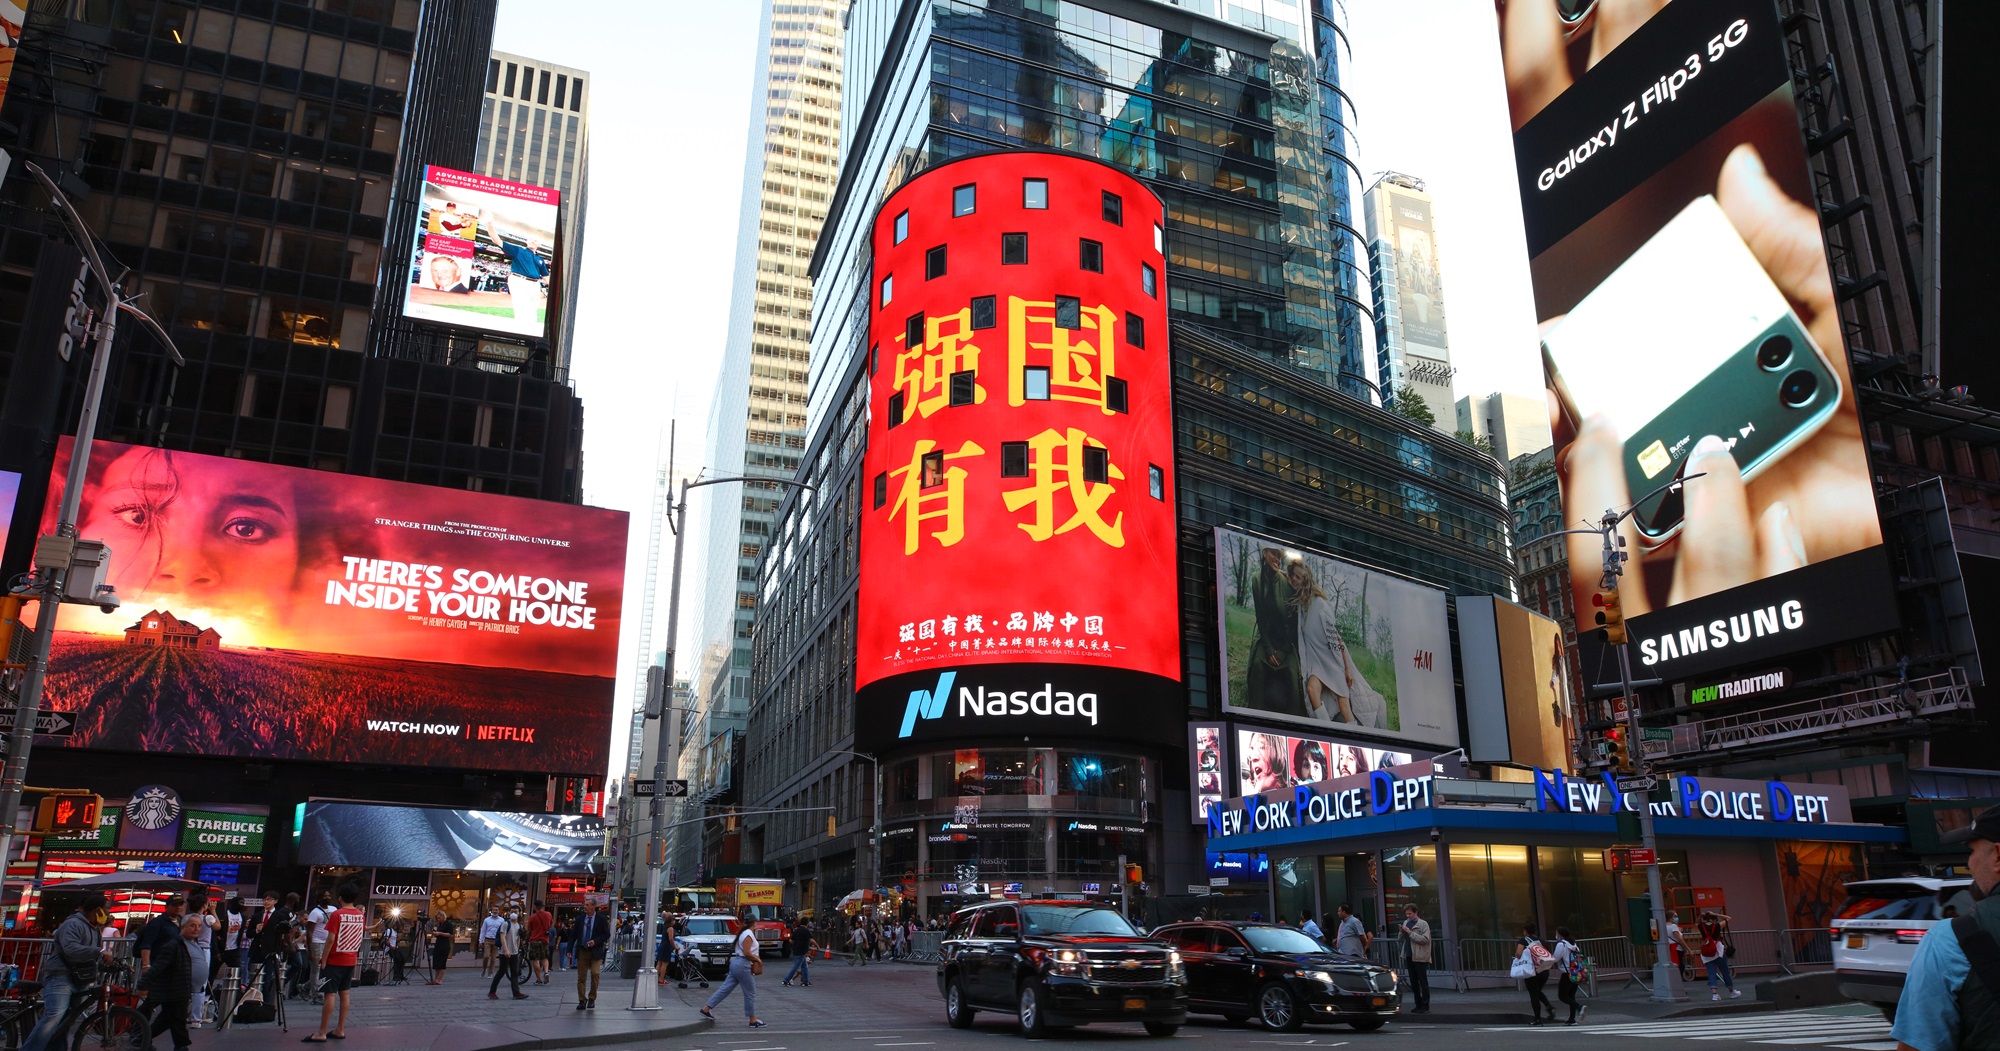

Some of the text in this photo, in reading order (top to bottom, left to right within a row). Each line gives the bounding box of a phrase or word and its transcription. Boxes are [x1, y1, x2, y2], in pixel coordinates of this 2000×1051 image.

[1538, 19, 1748, 191] Galaxy Z Flip3 5G
[436, 172, 548, 197] ADVANCED BLADDER CANCER
[473, 184, 498, 192] PATIENTS
[513, 192, 547, 201] CAREGIVERS
[892, 296, 1118, 424] 强国
[1670, 435, 1690, 453] Butter
[1673, 447, 1686, 459] BTS
[888, 428, 1125, 556] 有我
[375, 518, 420, 529] STRANGER
[422, 524, 453, 533] THINGS
[483, 531, 530, 542] CONJURING
[532, 537, 570, 547] UNIVERSE
[342, 556, 589, 604] THERE'S SOMEONE
[325, 580, 597, 630] INSIDE YOUR HOUSE
[429, 618, 446, 627] HENRY
[484, 622, 505, 633] PATRICK
[1640, 600, 1803, 666] SAMSUNG
[1414, 649, 1432, 672] H&M
[960, 683, 1098, 726] Nasdaq
[35, 718, 62, 728] WAY
[367, 720, 535, 743] WATCH NOW NETFLIX
[1645, 730, 1672, 738] Broadway
[1434, 763, 1444, 772] THE
[1207, 770, 1432, 839] NEW YORK POLICE DEPT
[1533, 766, 1601, 812] NEW
[1677, 776, 1764, 820] POLICE
[1766, 782, 1828, 822] DEPT
[187, 818, 264, 834] STARBUCKS
[198, 833, 248, 846] COFFEE
[375, 884, 428, 896] CITIZEN
[340, 914, 364, 922] WHITE
